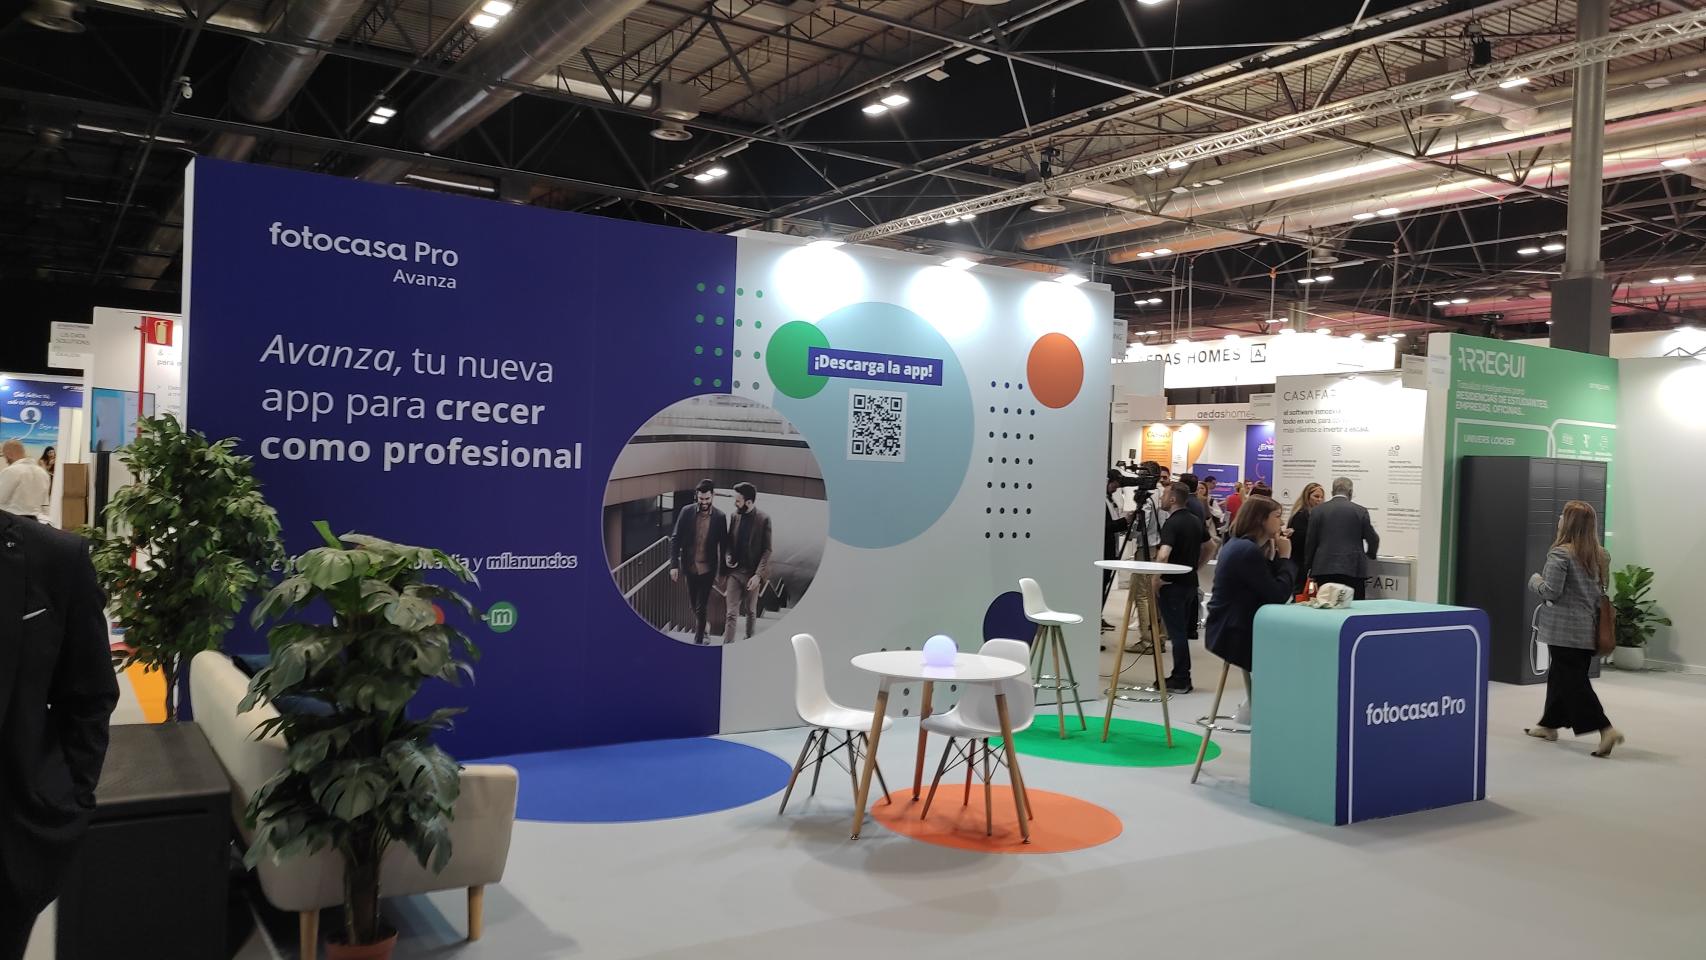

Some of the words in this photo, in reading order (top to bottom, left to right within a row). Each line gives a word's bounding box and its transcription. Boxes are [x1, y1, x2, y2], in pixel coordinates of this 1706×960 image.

[269, 222, 408, 262] fotocasa
[414, 241, 459, 267] Pro
[393, 269, 457, 289] Avanza
[259, 334, 402, 377] Avanza,
[412, 348, 445, 376] tu
[458, 356, 553, 383] nueva
[814, 354, 885, 376] ¡Descarga
[888, 360, 901, 375] la
[903, 365, 934, 380] app!
[1187, 348, 1242, 364] HOMES
[261, 388, 334, 422] app
[346, 392, 426, 424] para
[436, 398, 546, 425] crecer
[260, 435, 371, 463] como
[383, 437, 582, 472] profesional
[473, 557, 484, 573] y
[486, 552, 578, 570] milanuncios
[1366, 701, 1439, 726] fotocasa
[1441, 695, 1466, 716] Pro
